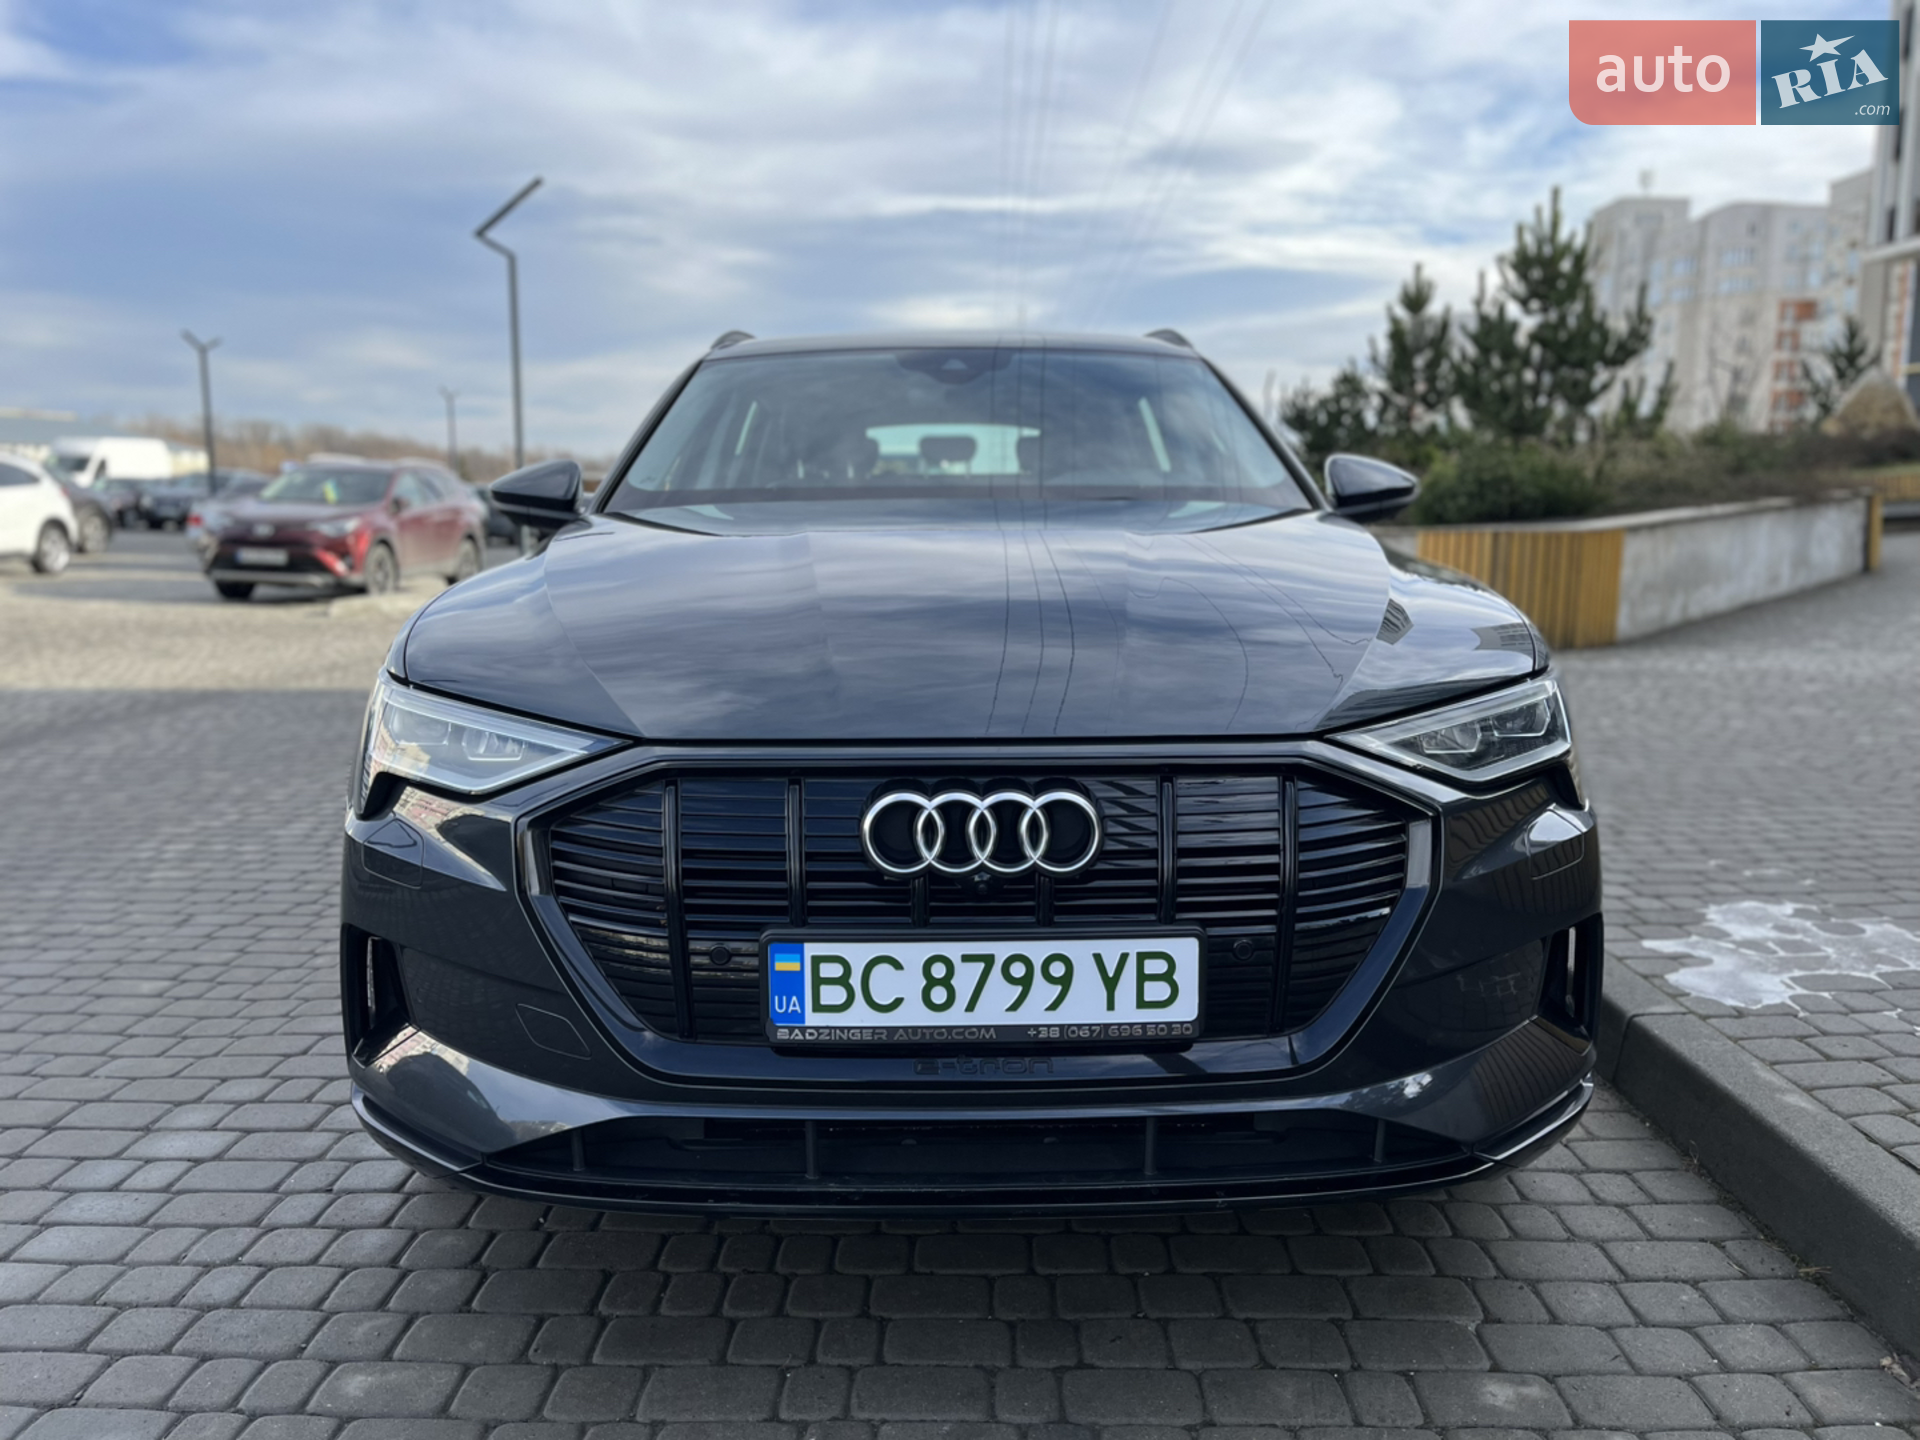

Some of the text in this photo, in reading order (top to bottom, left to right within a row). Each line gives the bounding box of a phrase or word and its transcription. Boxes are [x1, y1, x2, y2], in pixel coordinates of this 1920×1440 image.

[810, 950, 1180, 1014] BC 8799 YB
[774, 995, 801, 1015] UA
[776, 1027, 997, 1041] BADZINGER AUTO.COM
[1027, 1022, 1193, 1039] +38 (067) 696 50 30
[913, 1054, 1055, 1075] e-tron
